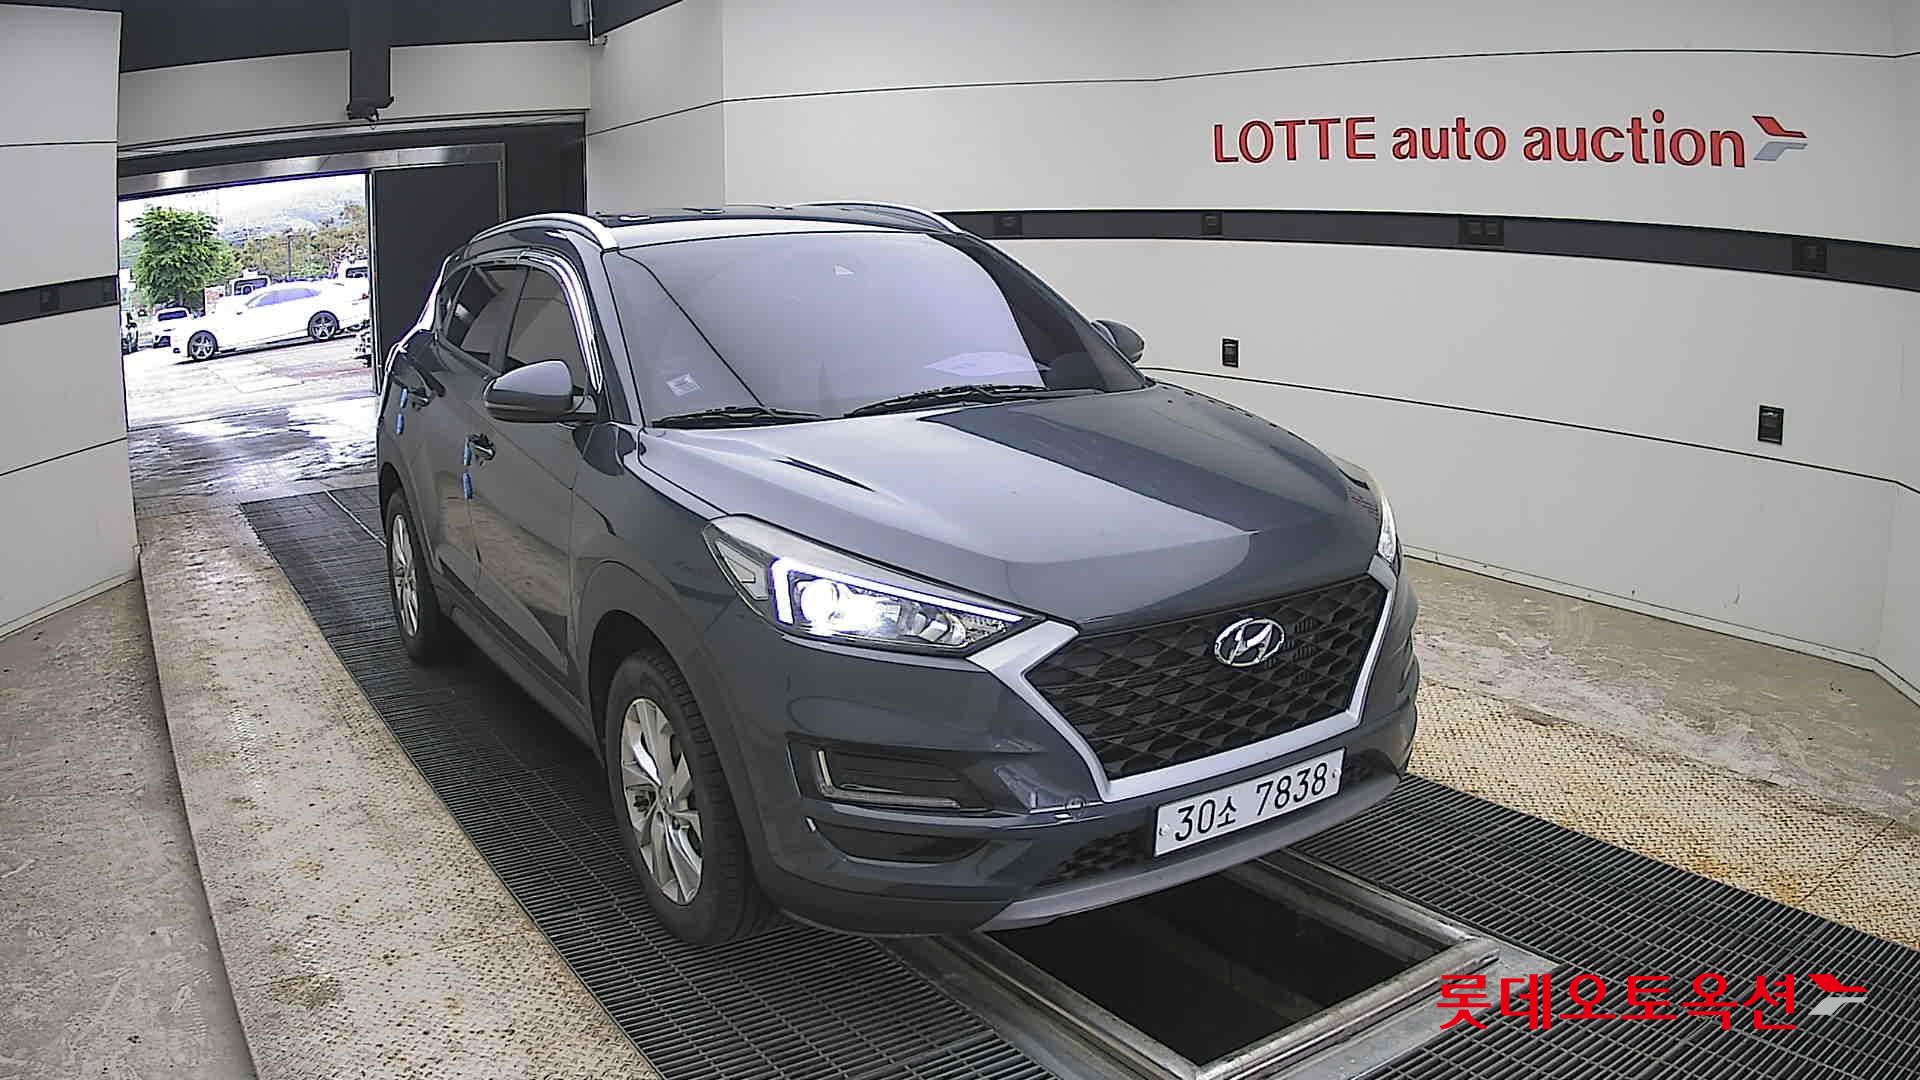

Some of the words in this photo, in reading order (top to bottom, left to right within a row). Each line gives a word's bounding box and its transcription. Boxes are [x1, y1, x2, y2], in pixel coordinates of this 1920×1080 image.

[1213, 116, 1376, 163] LOTTE
[1392, 117, 1507, 160] auto
[1522, 109, 1746, 168] auction
[1174, 795, 1237, 842] 30소
[1255, 762, 1328, 816] 7838
